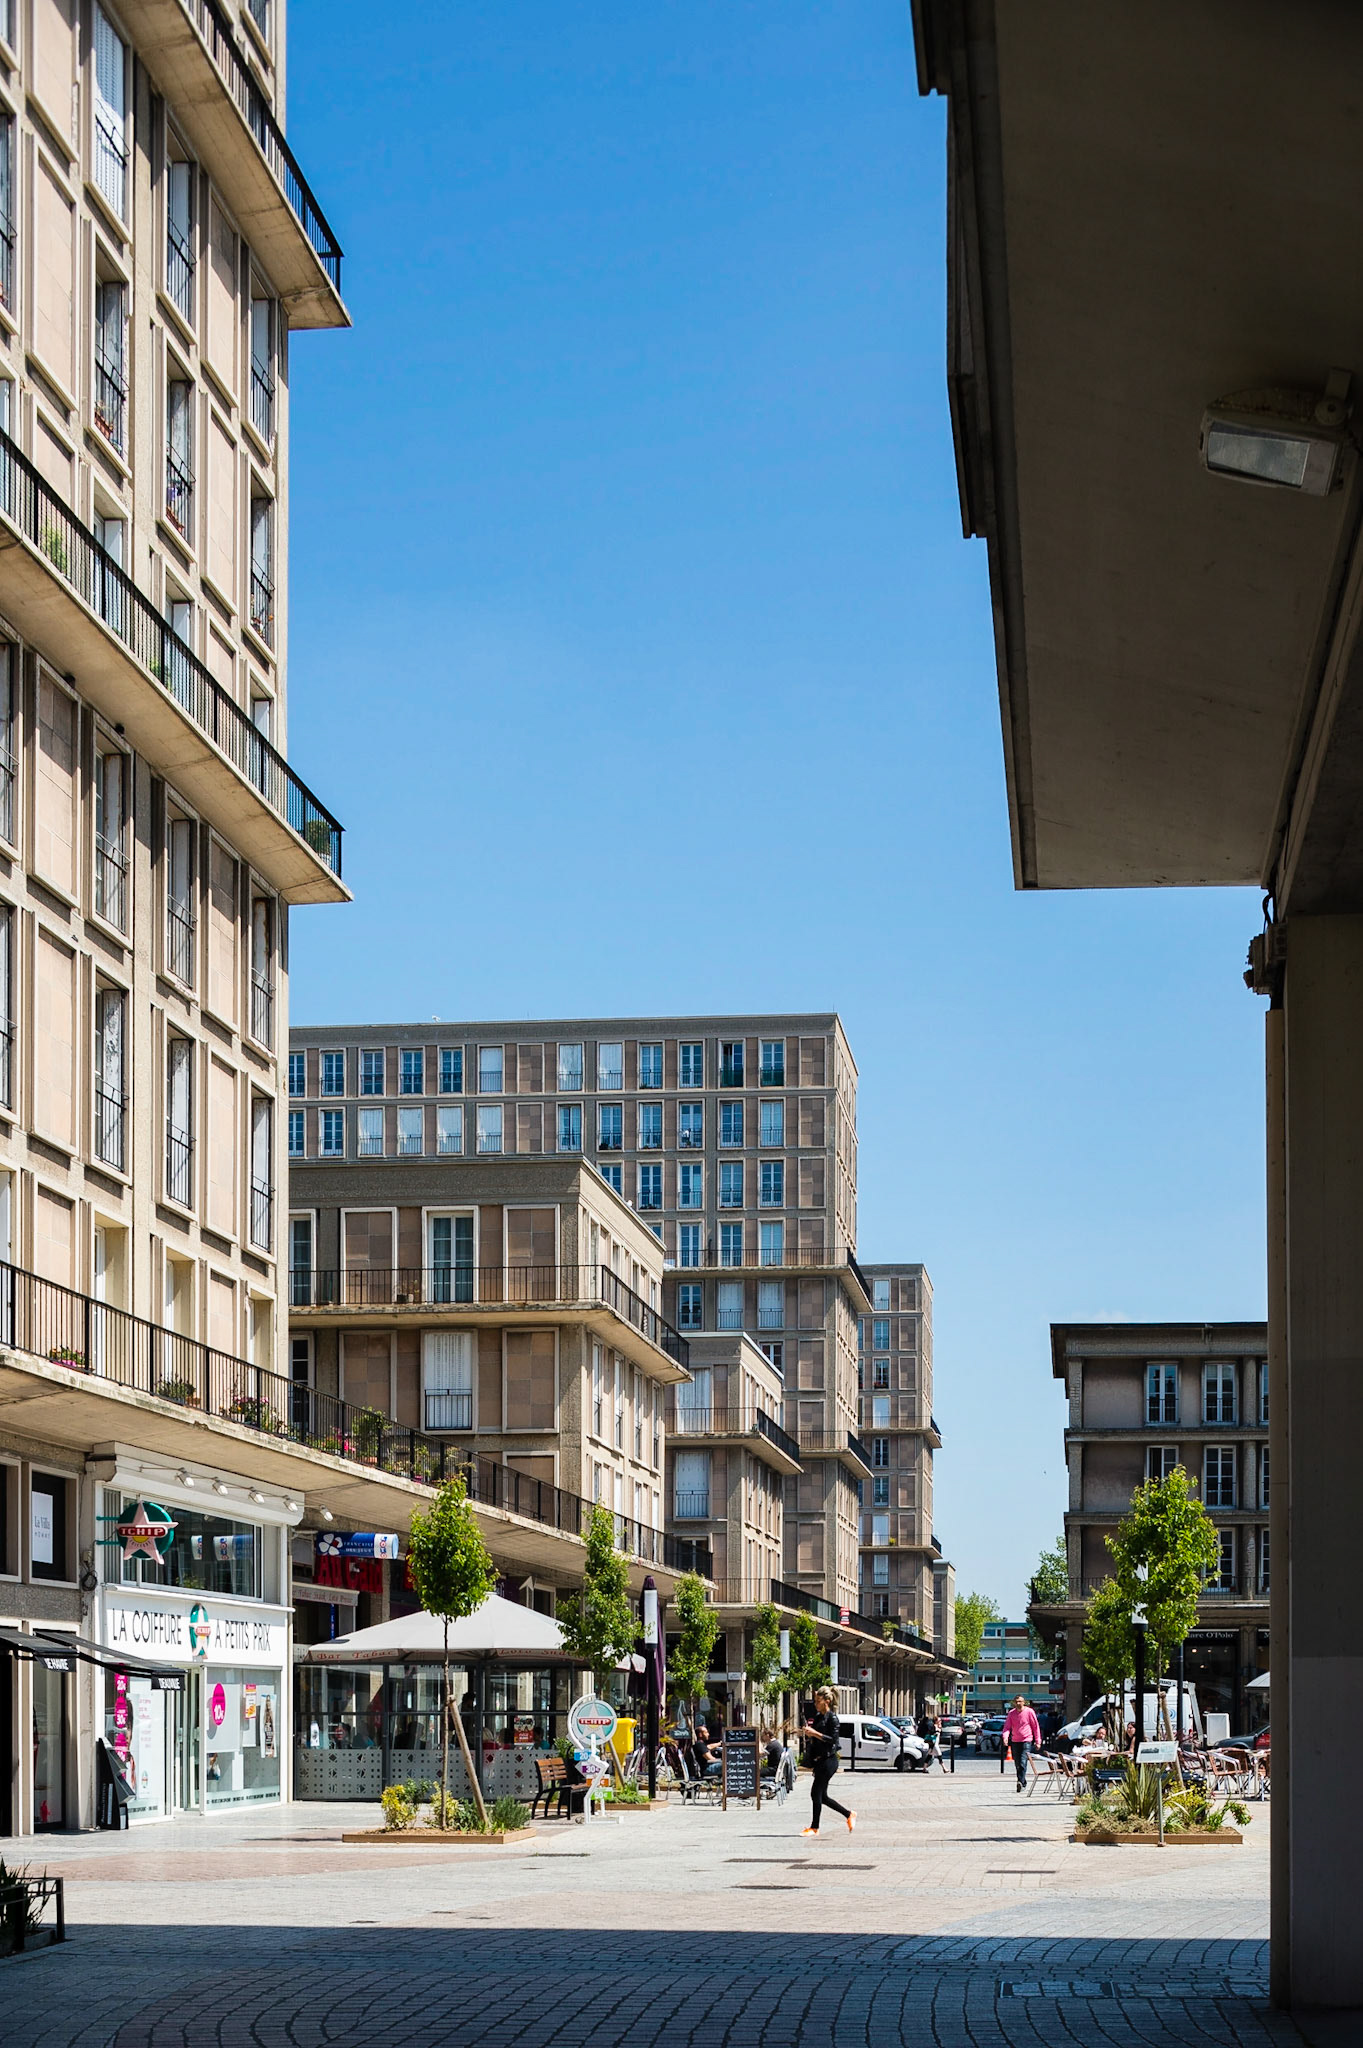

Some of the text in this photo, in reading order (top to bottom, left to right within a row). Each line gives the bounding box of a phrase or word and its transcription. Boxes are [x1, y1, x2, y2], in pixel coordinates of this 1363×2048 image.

[121, 1528, 164, 1536] TCHIP
[112, 1608, 127, 1642] LA
[132, 1610, 182, 1645] COIFFURE
[225, 1619, 249, 1650] PETITS
[253, 1622, 271, 1651] PRIX
[352, 1650, 394, 1659] Tabac
